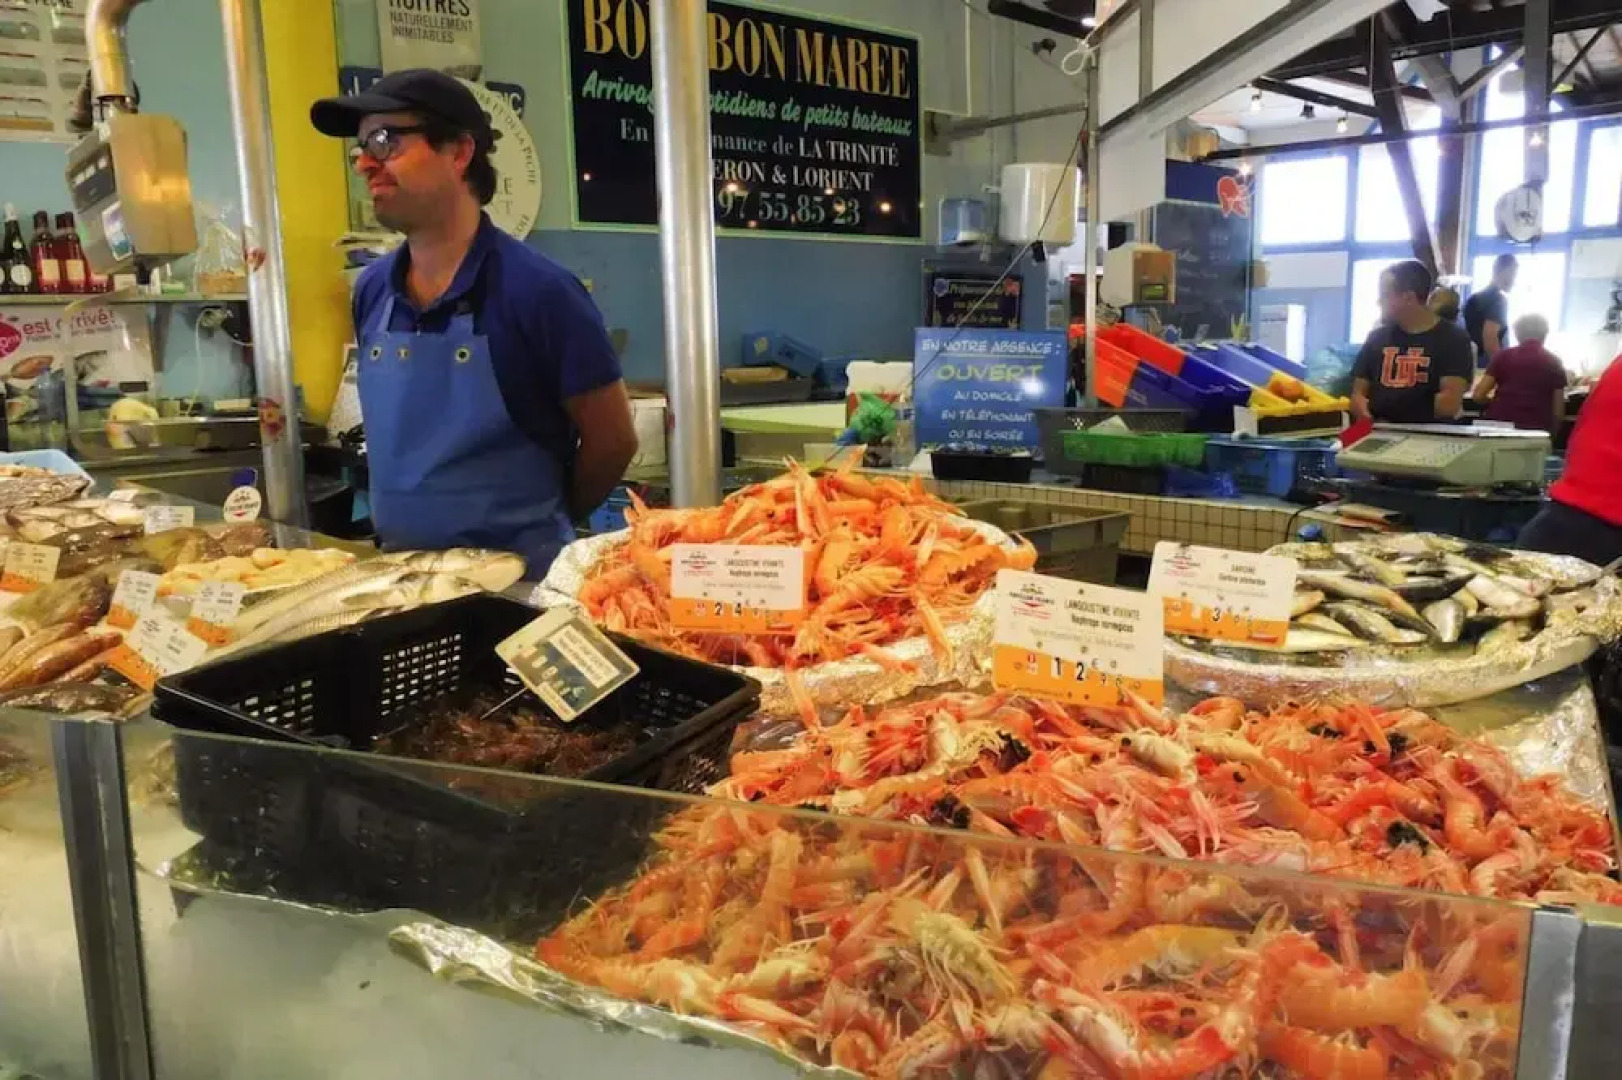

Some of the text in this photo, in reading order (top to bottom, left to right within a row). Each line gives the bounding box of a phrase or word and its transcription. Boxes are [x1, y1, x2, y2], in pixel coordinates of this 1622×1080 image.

[390, 12, 473, 32] NATURELLEMENT
[392, 27, 455, 43] INIMITABLES
[584, 0, 911, 100] BOBON MAREE
[582, 69, 914, 136] Arriva tidiens de petits bateaux
[620, 117, 900, 167] En nance de LA TRINITÉ
[713, 158, 875, 192] ERON & LORIENT
[718, 186, 749, 220] 97
[758, 191, 788, 221] 55
[797, 194, 826, 224] 85
[23, 318, 51, 335] est
[922, 339, 940, 351] EN
[944, 340, 987, 351] NOTRE
[991, 341, 1052, 354] ABSENCE
[935, 363, 1044, 381] OUVERT
[954, 390, 970, 400] AU
[941, 409, 956, 420] EN
[948, 429, 964, 440] OU
[966, 429, 982, 440] EN
